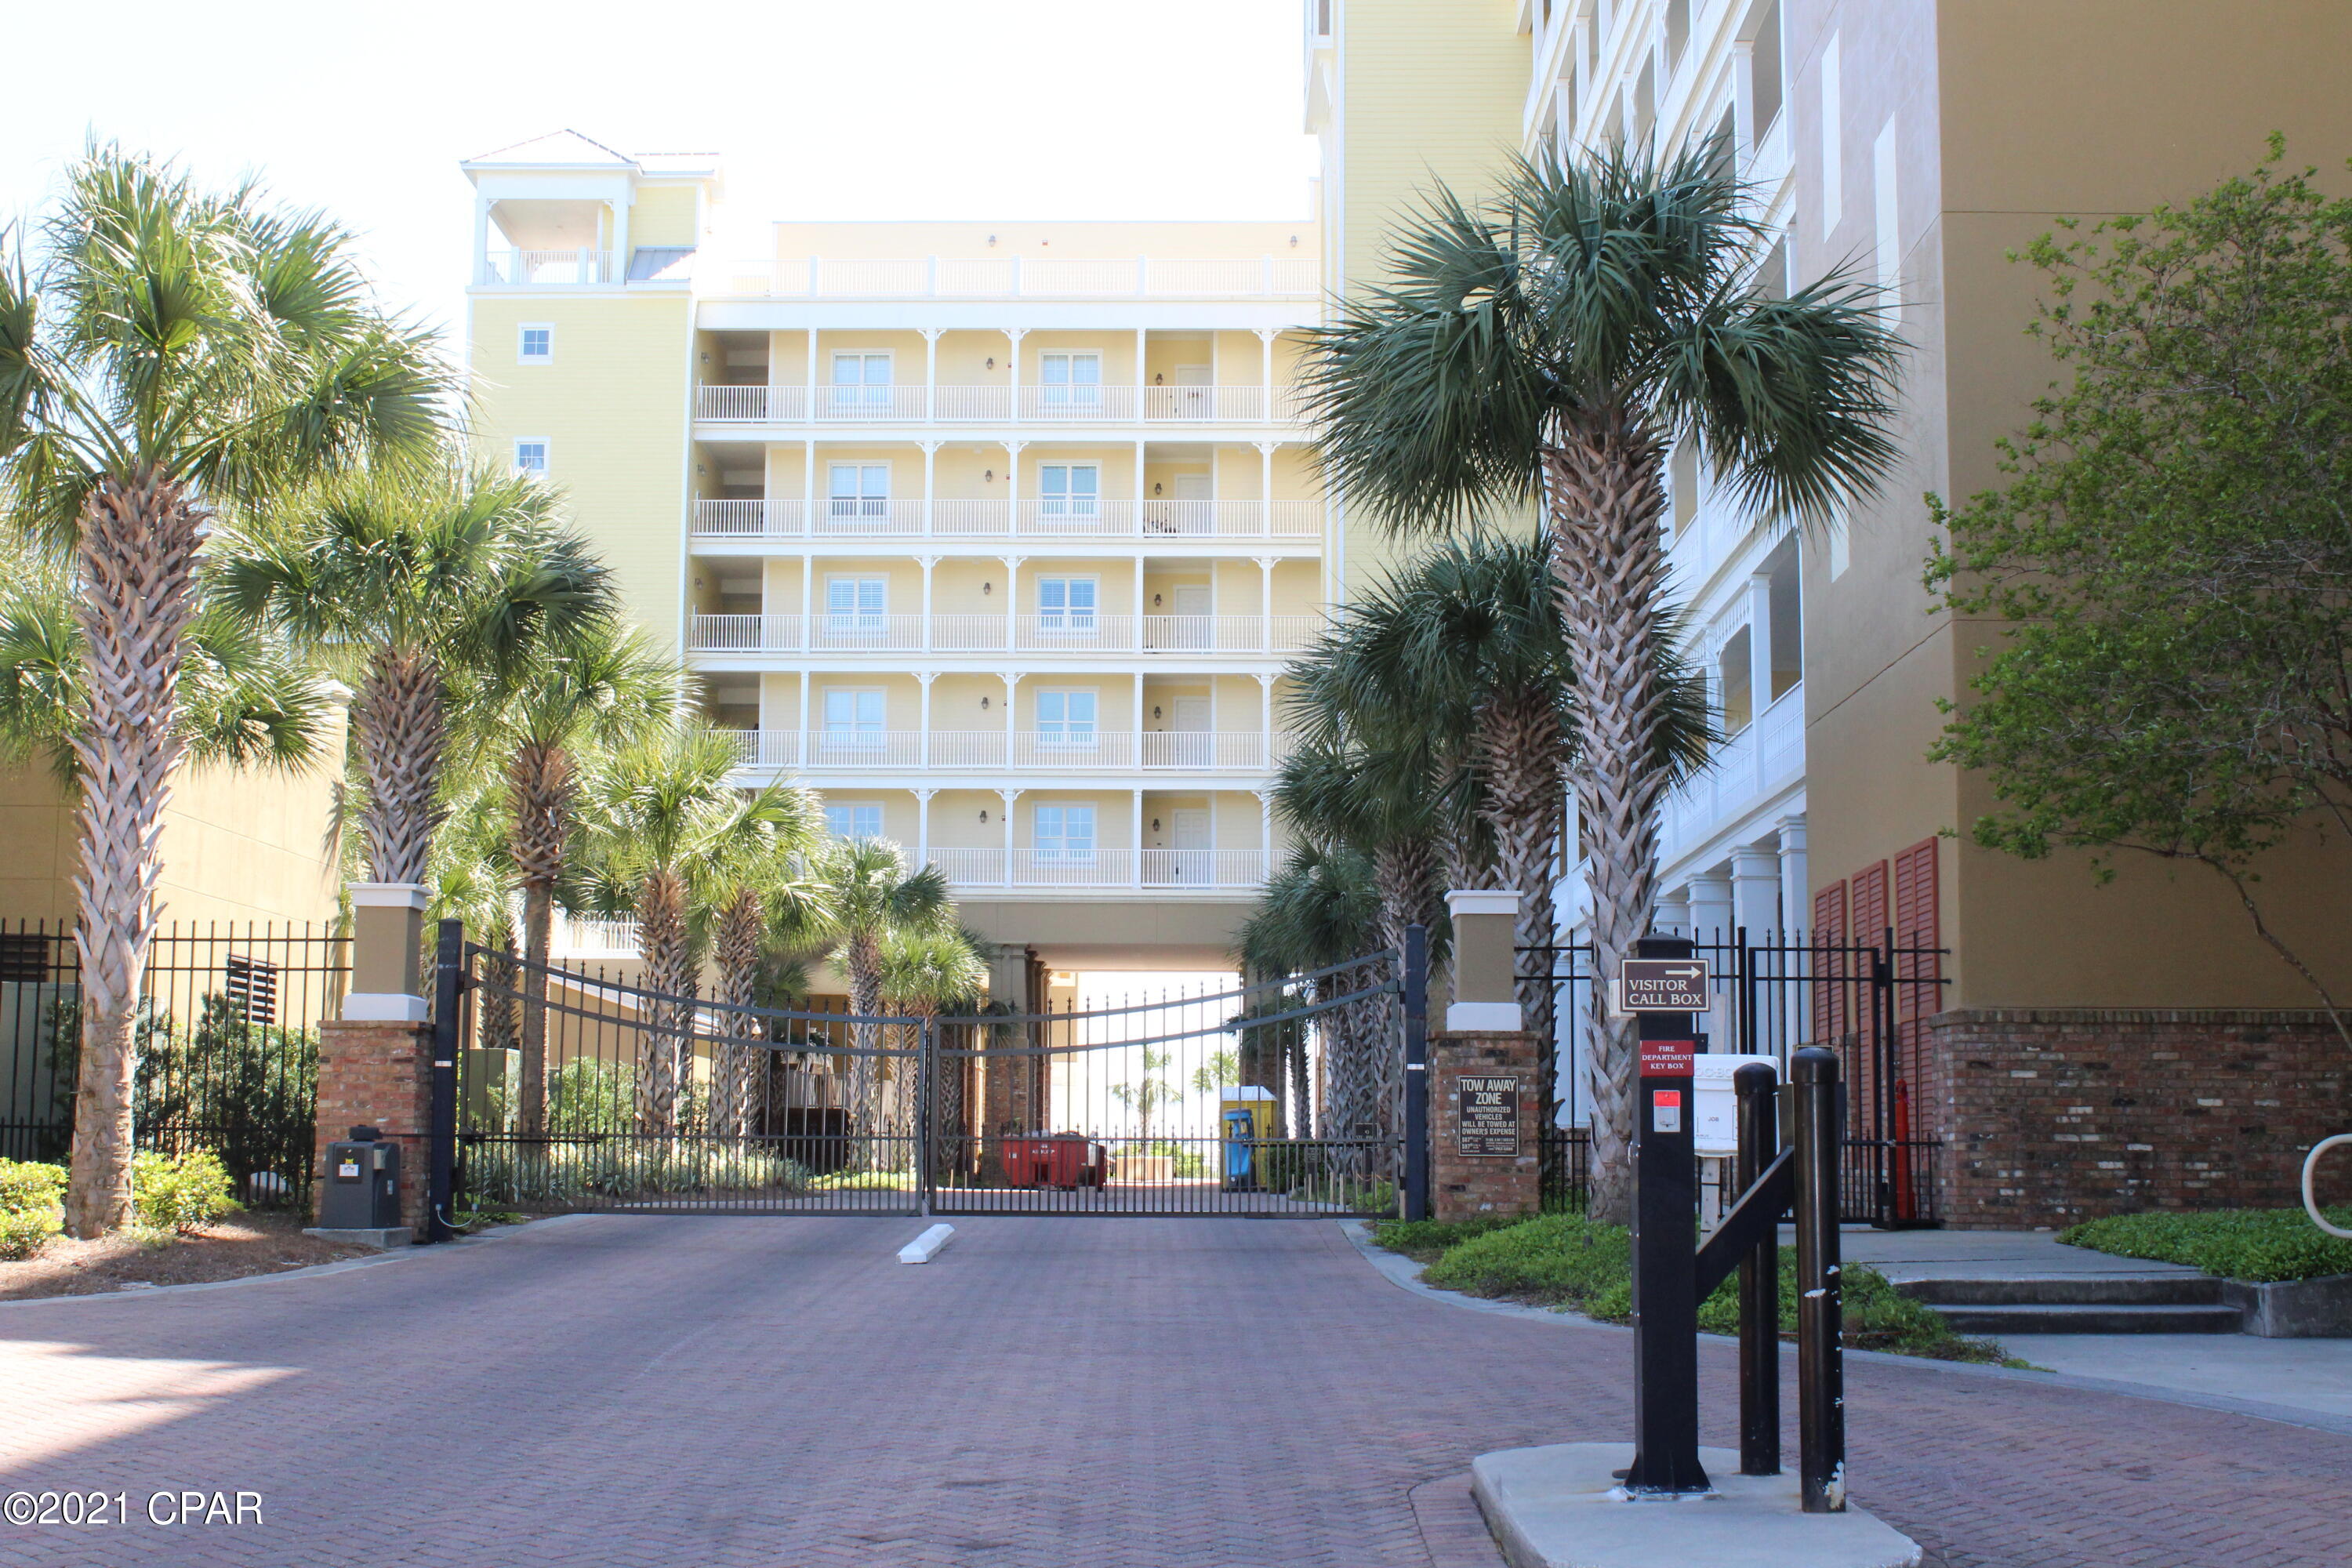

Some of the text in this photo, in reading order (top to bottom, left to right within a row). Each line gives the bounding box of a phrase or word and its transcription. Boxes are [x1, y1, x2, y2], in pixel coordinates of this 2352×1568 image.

[1629, 979, 1688, 991] VISITOR
[1629, 993, 1702, 1005] CALL BOX
[1461, 1079, 1516, 1091] TOW AWAY
[1475, 1092, 1502, 1105] ZONE
